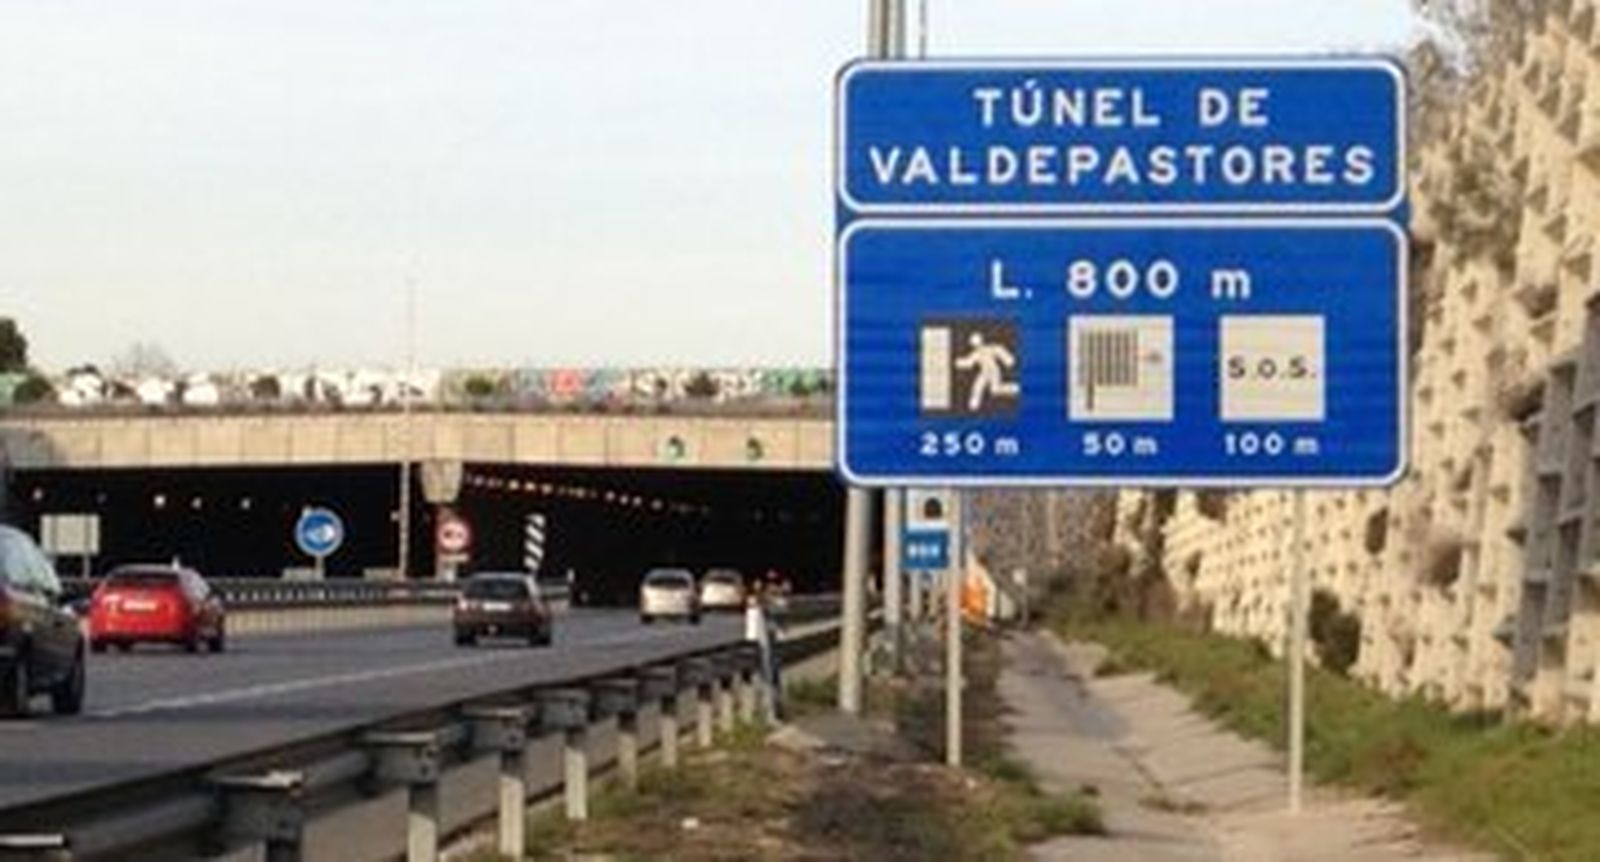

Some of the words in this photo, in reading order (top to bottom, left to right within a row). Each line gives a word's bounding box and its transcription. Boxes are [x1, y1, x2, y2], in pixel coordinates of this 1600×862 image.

[973, 79, 1160, 127] TÚNEL
[1198, 88, 1270, 127] DE
[869, 145, 1375, 186] VALDEPASTORES
[991, 260, 1033, 299] L.
[1066, 259, 1179, 299] 800
[1211, 269, 1252, 299] m
[1227, 356, 1316, 379] S.O.S.
[919, 433, 985, 456] 250
[995, 437, 1019, 455] m
[1083, 433, 1126, 456] 50
[1133, 437, 1158, 455] m
[1224, 432, 1284, 455] 100
[1294, 437, 1319, 455] m
